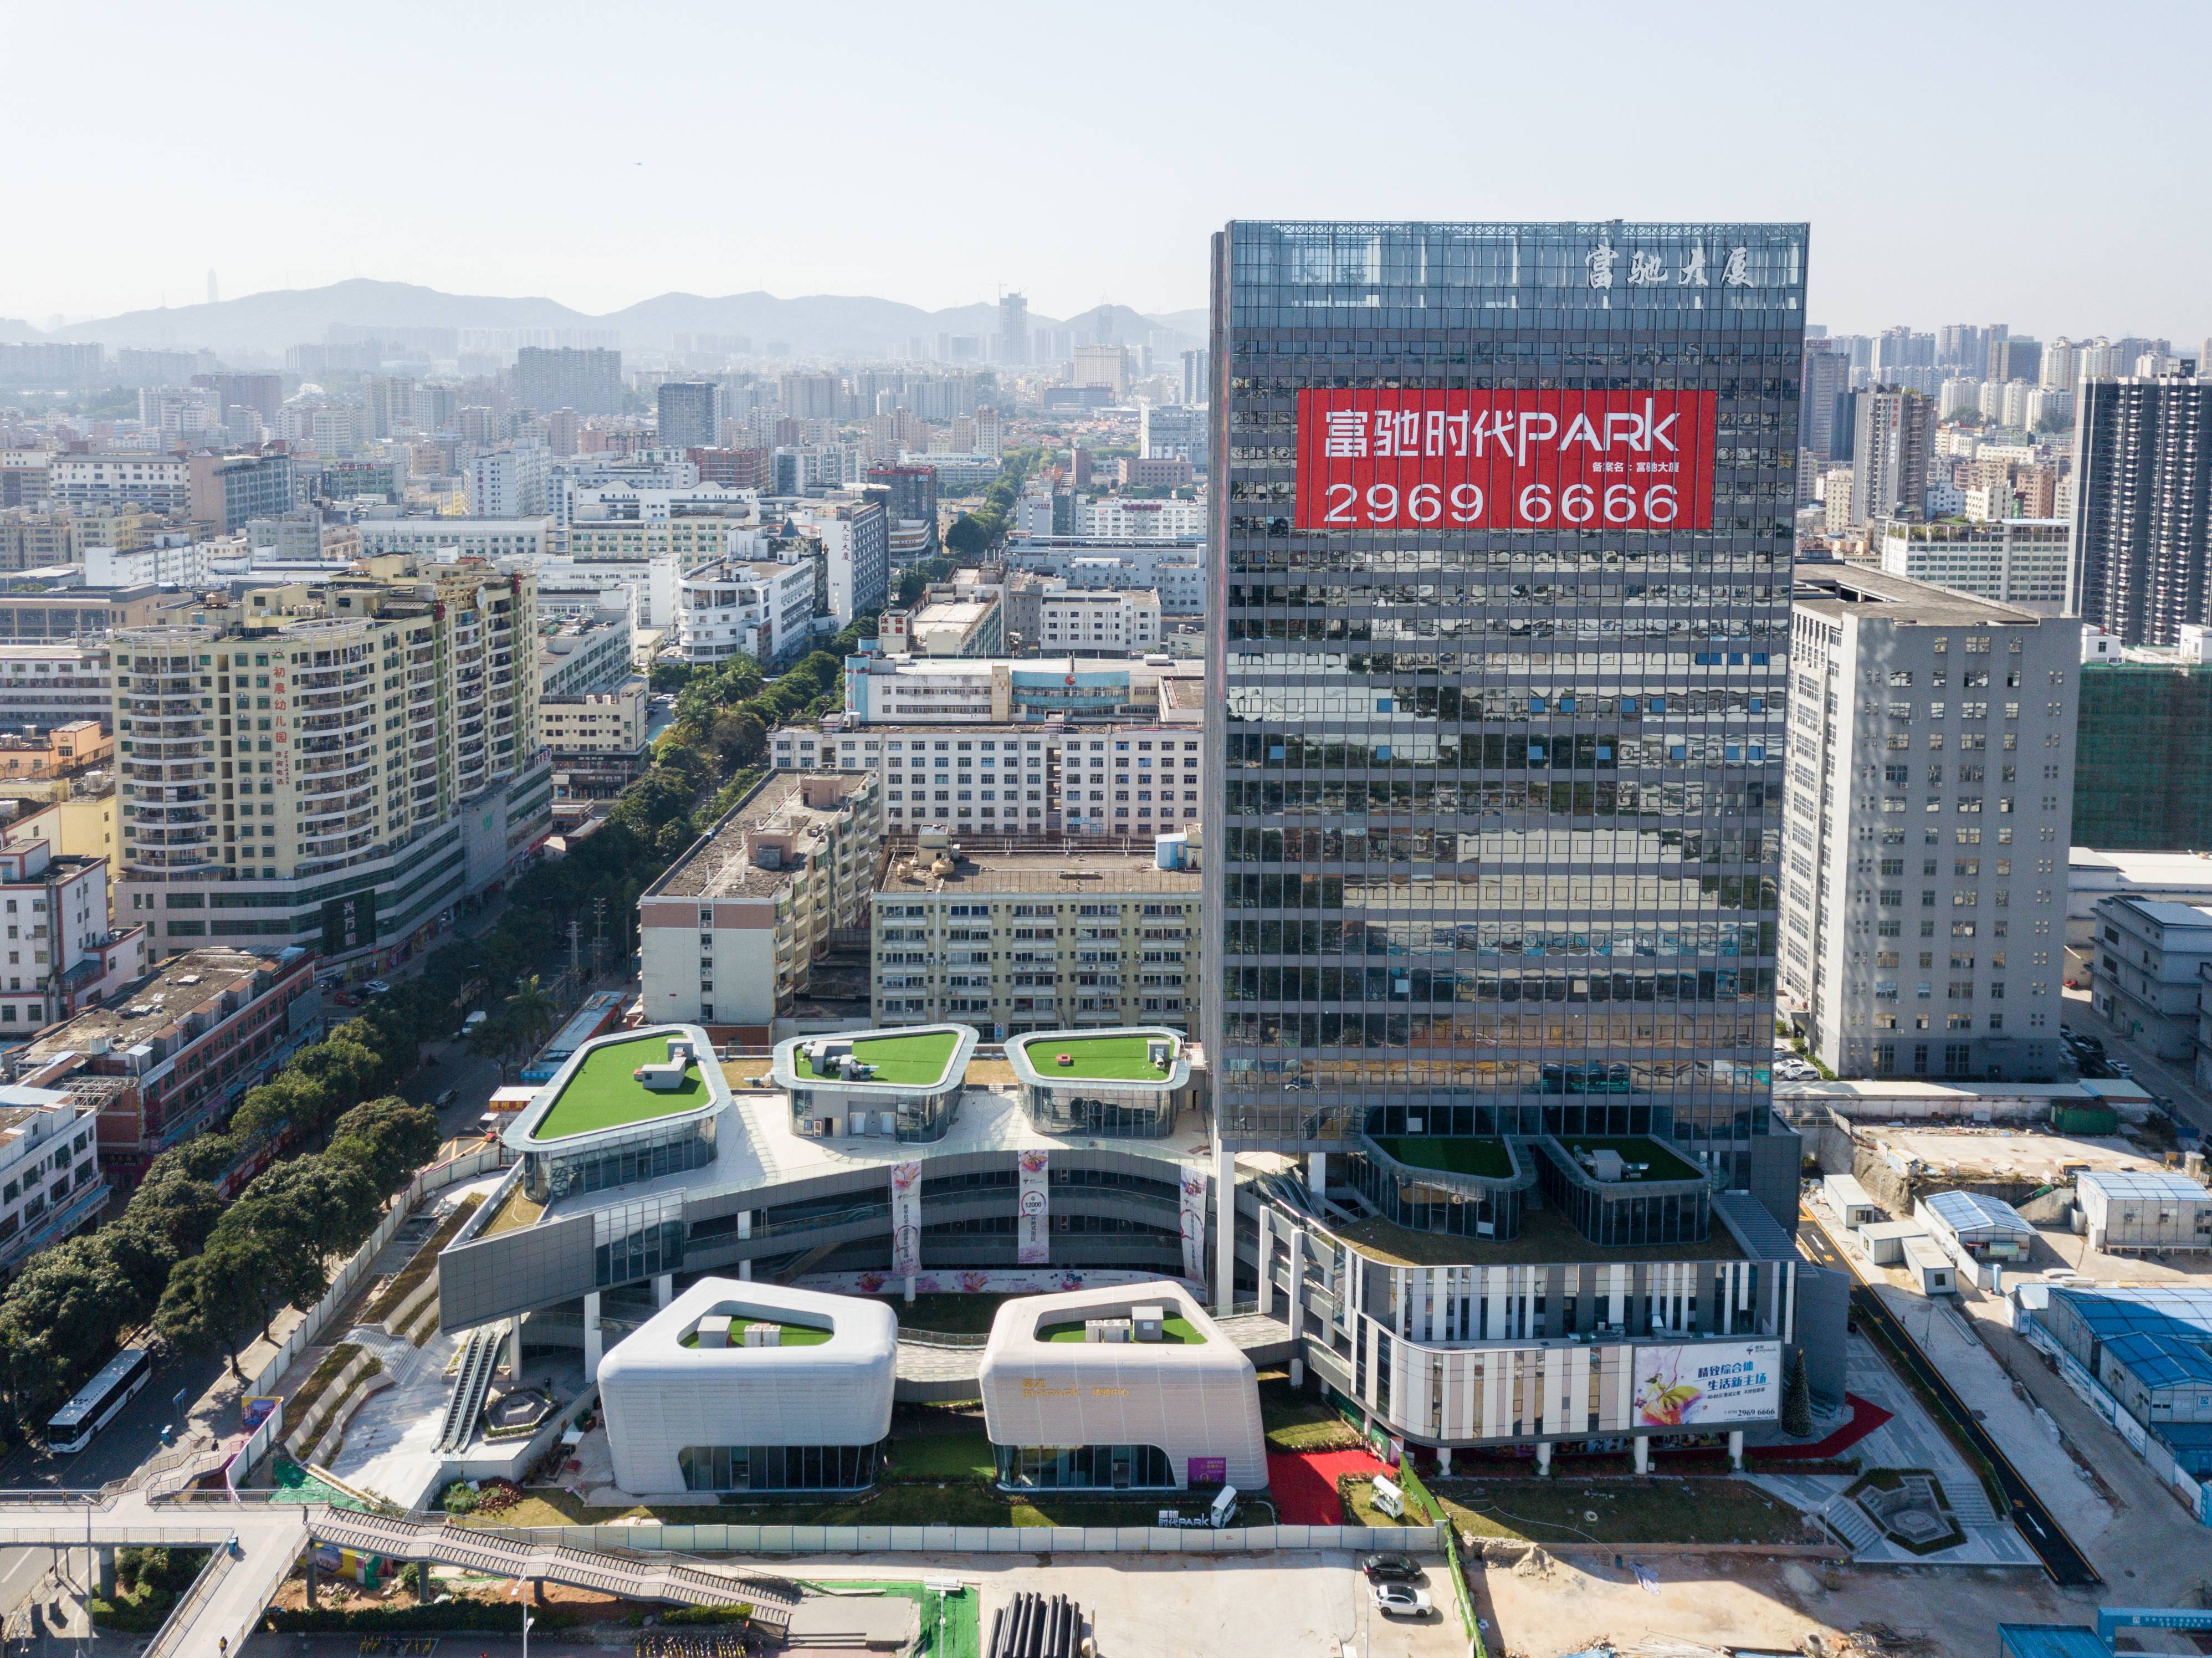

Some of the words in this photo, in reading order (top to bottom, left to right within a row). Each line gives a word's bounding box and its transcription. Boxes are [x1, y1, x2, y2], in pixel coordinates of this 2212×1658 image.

[1323, 483, 1484, 522] 2969
[1519, 483, 1678, 522] 6666
[1698, 1361, 1754, 1378] 精致综合体
[1707, 1373, 1767, 1391] 生活新主场
